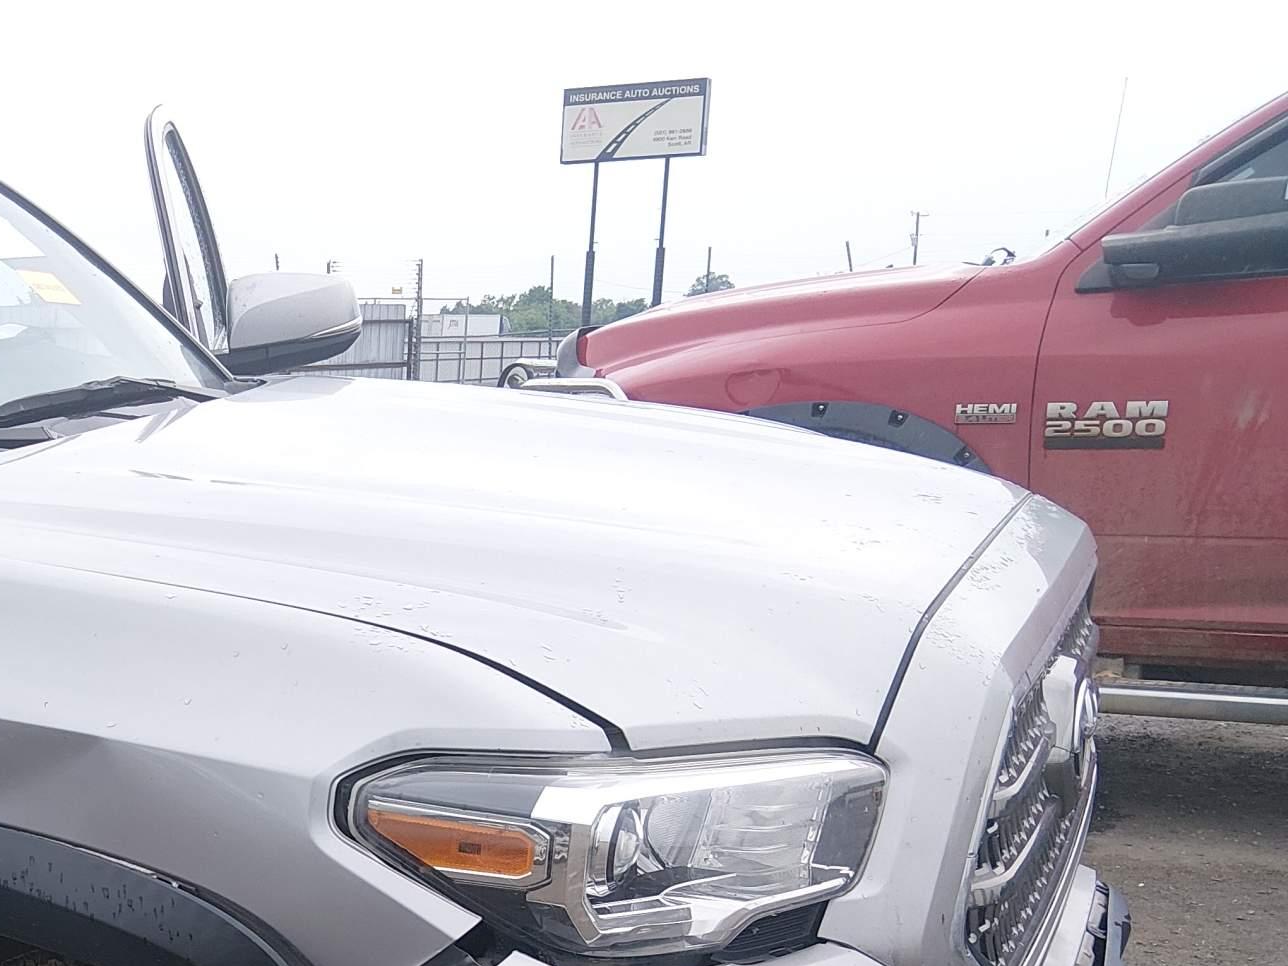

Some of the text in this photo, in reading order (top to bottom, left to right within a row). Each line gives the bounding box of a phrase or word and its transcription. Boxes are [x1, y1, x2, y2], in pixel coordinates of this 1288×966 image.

[569, 84, 700, 103] INSURANCE AUTO AUCTIONS
[955, 403, 1017, 414] HEMI
[1046, 400, 1169, 419] RAM
[1044, 419, 1167, 438] 2500
